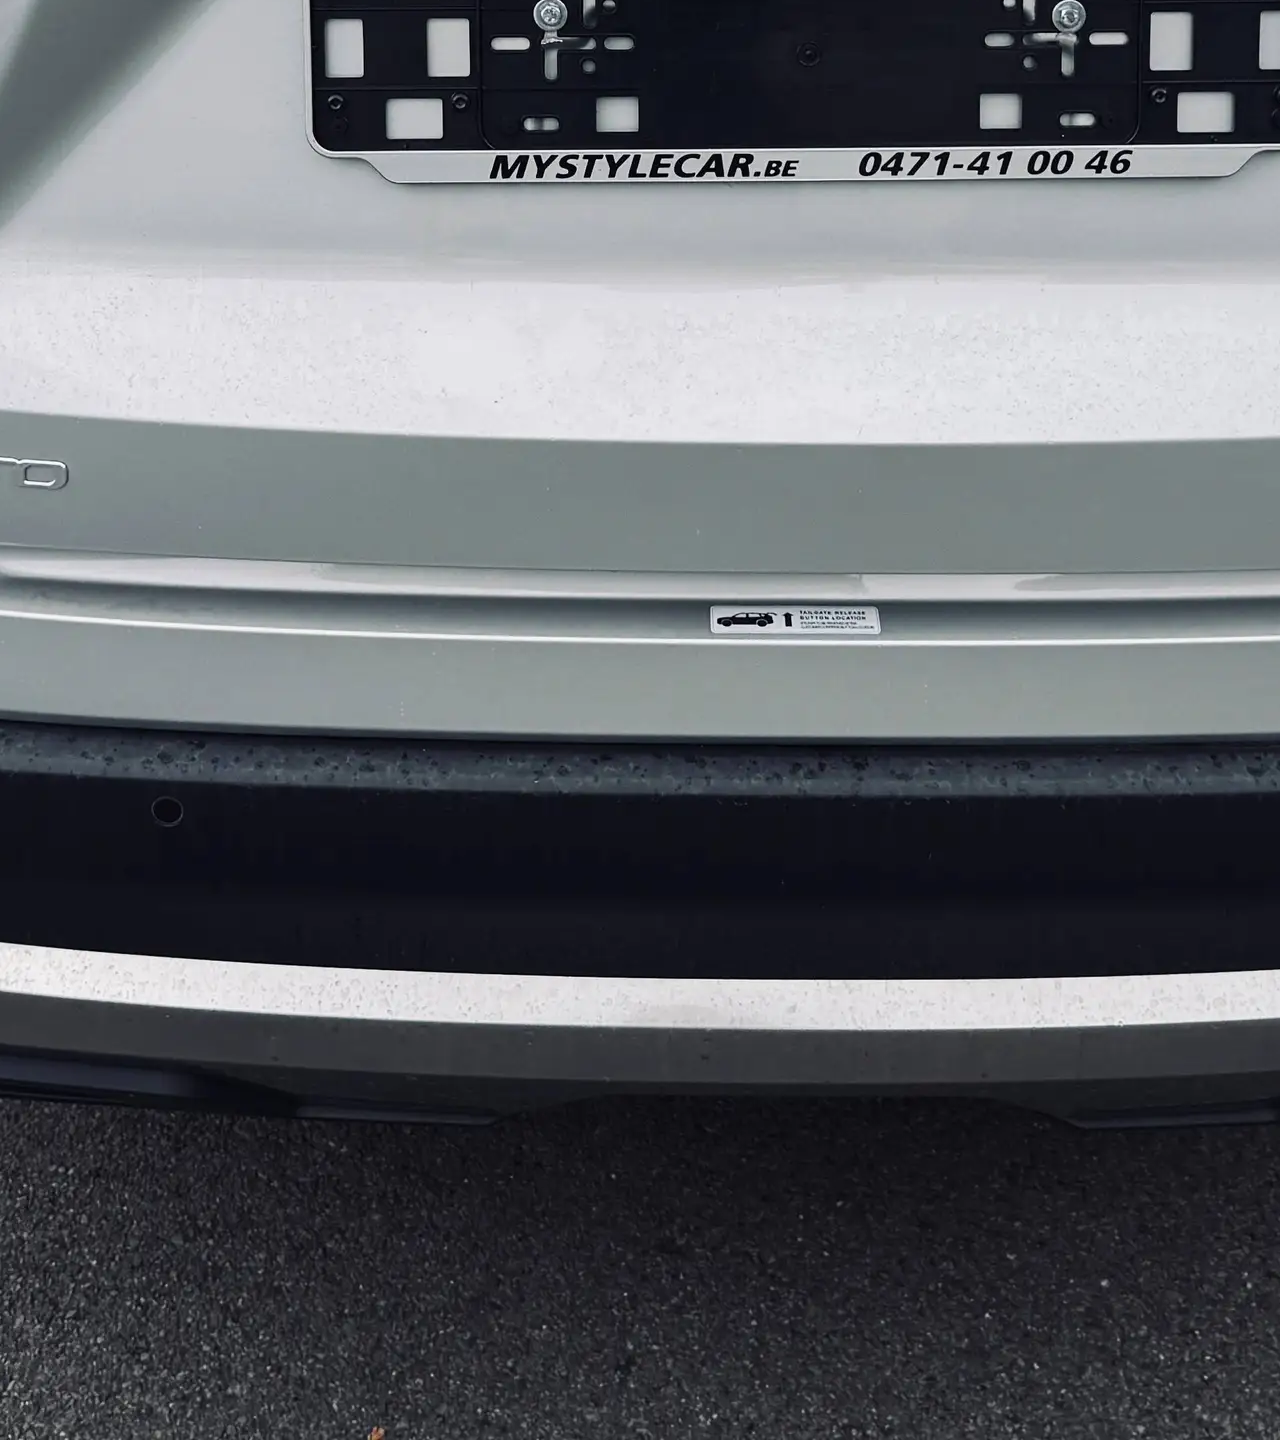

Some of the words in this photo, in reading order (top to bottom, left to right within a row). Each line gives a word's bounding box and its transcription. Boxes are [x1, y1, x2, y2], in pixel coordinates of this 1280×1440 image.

[489, 153, 799, 179] MYSTYLECAR.BE
[858, 151, 1013, 176] 0471-41
[1027, 150, 1074, 175] 00
[1084, 150, 1133, 174] 46
